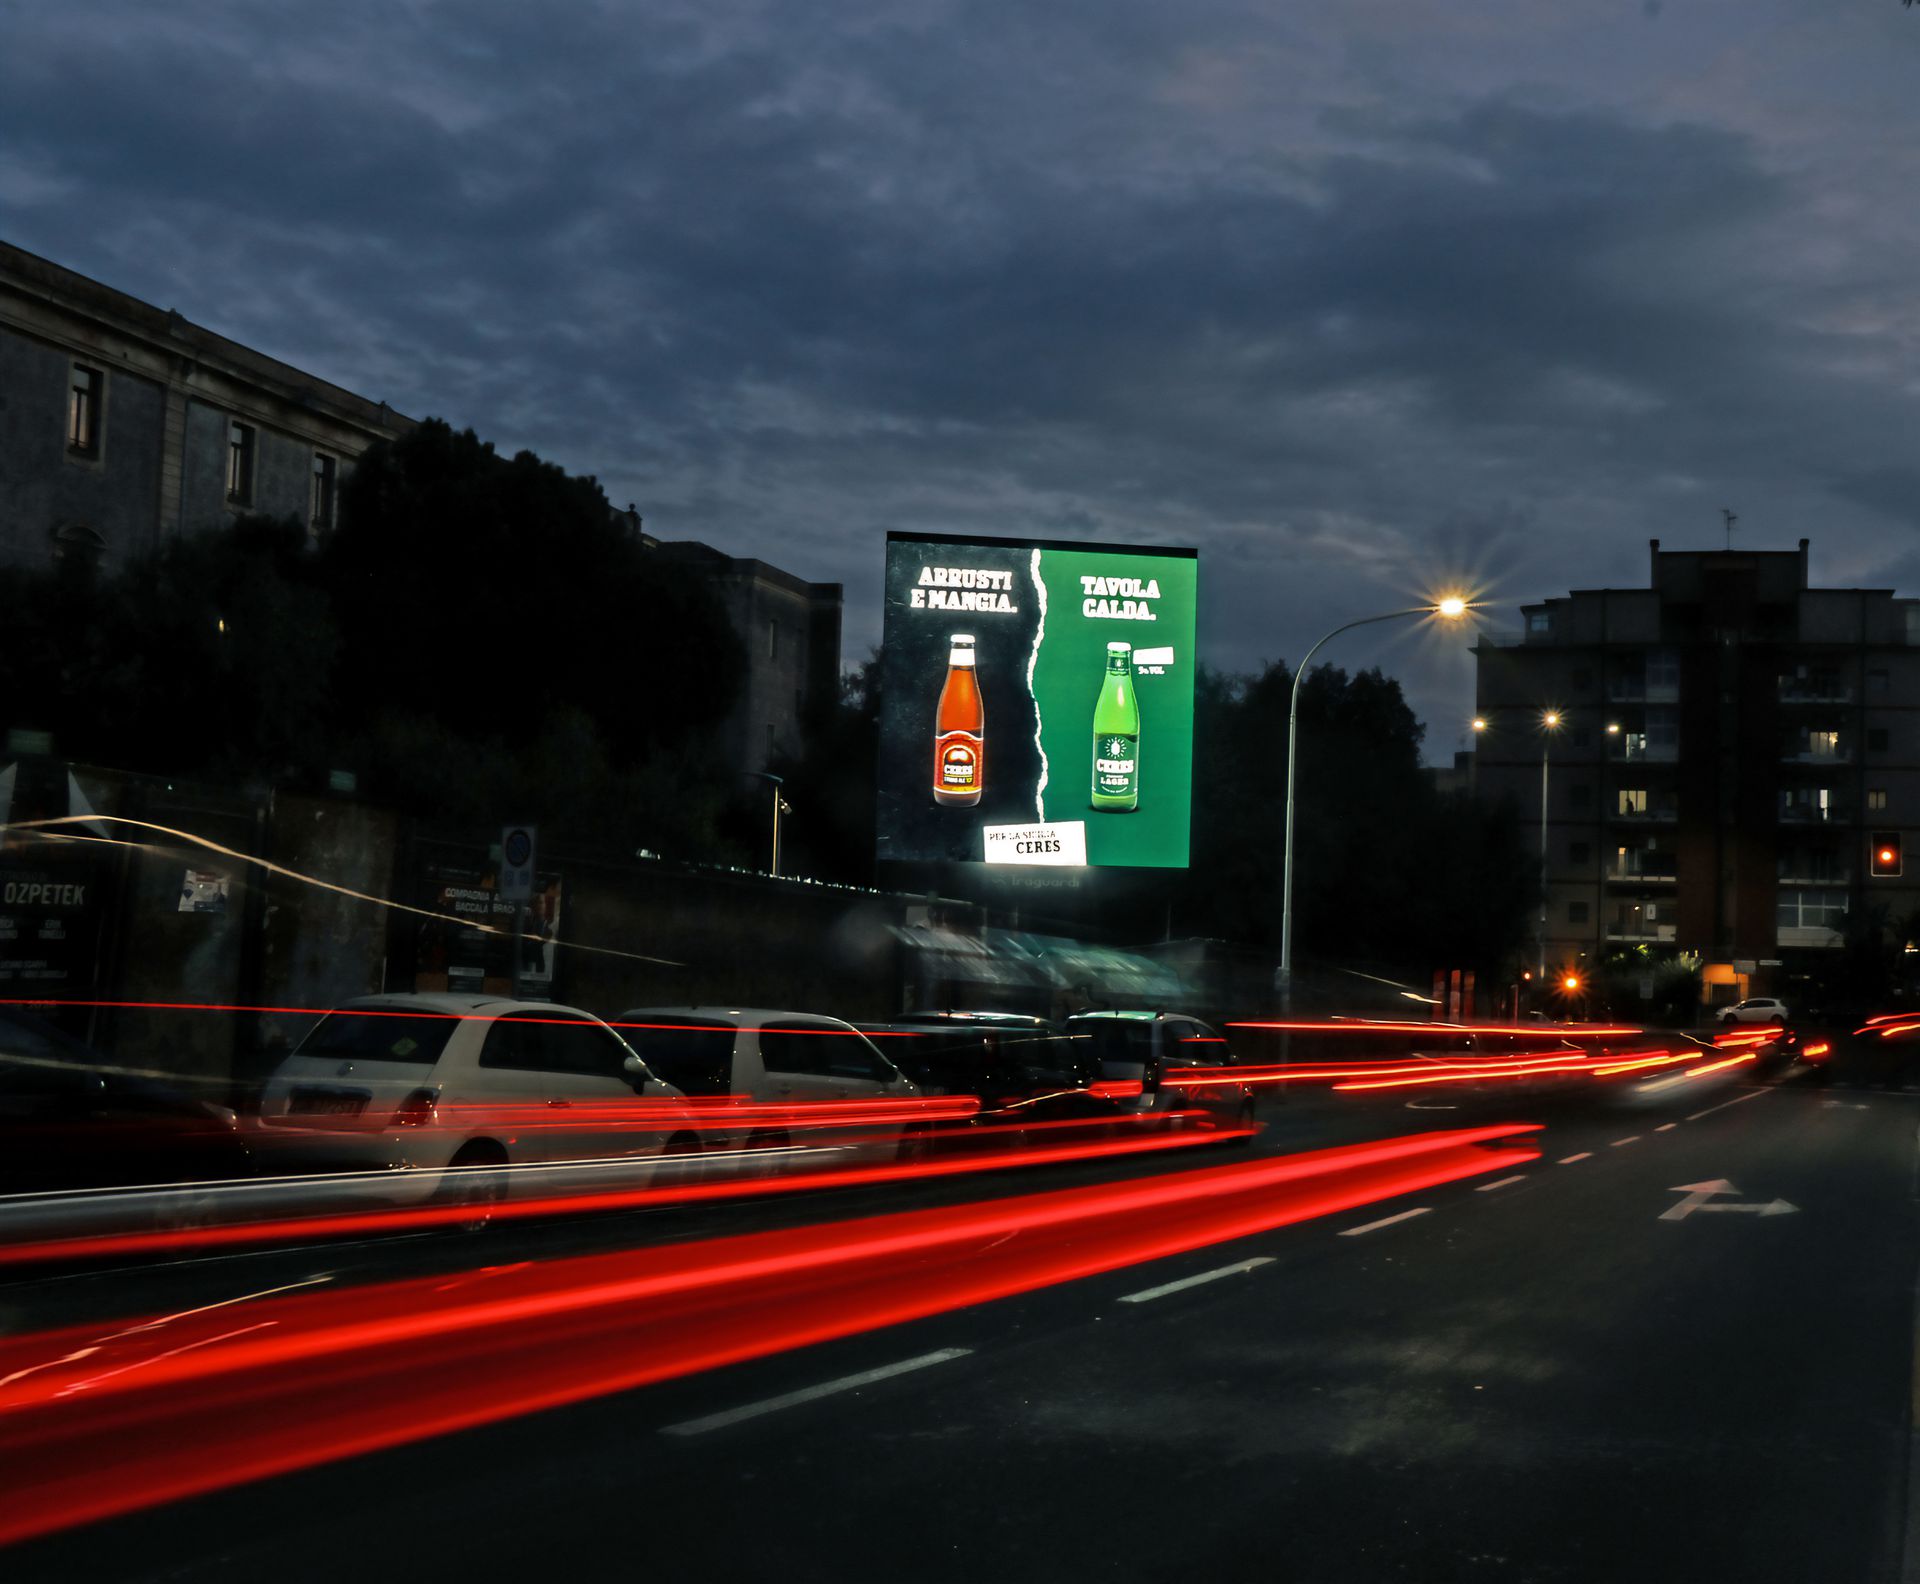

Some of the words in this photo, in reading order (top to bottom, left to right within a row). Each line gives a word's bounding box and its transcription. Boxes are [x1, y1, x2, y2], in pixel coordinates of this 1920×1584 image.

[918, 566, 1012, 590] ARRUSTI
[1080, 576, 1161, 599] TAVOLA
[910, 588, 926, 608] E
[927, 589, 1018, 614] MANGIA.
[1082, 598, 1157, 621] CALDA.
[1016, 840, 1061, 854] CERES
[4, 881, 86, 905] OZPETEK
